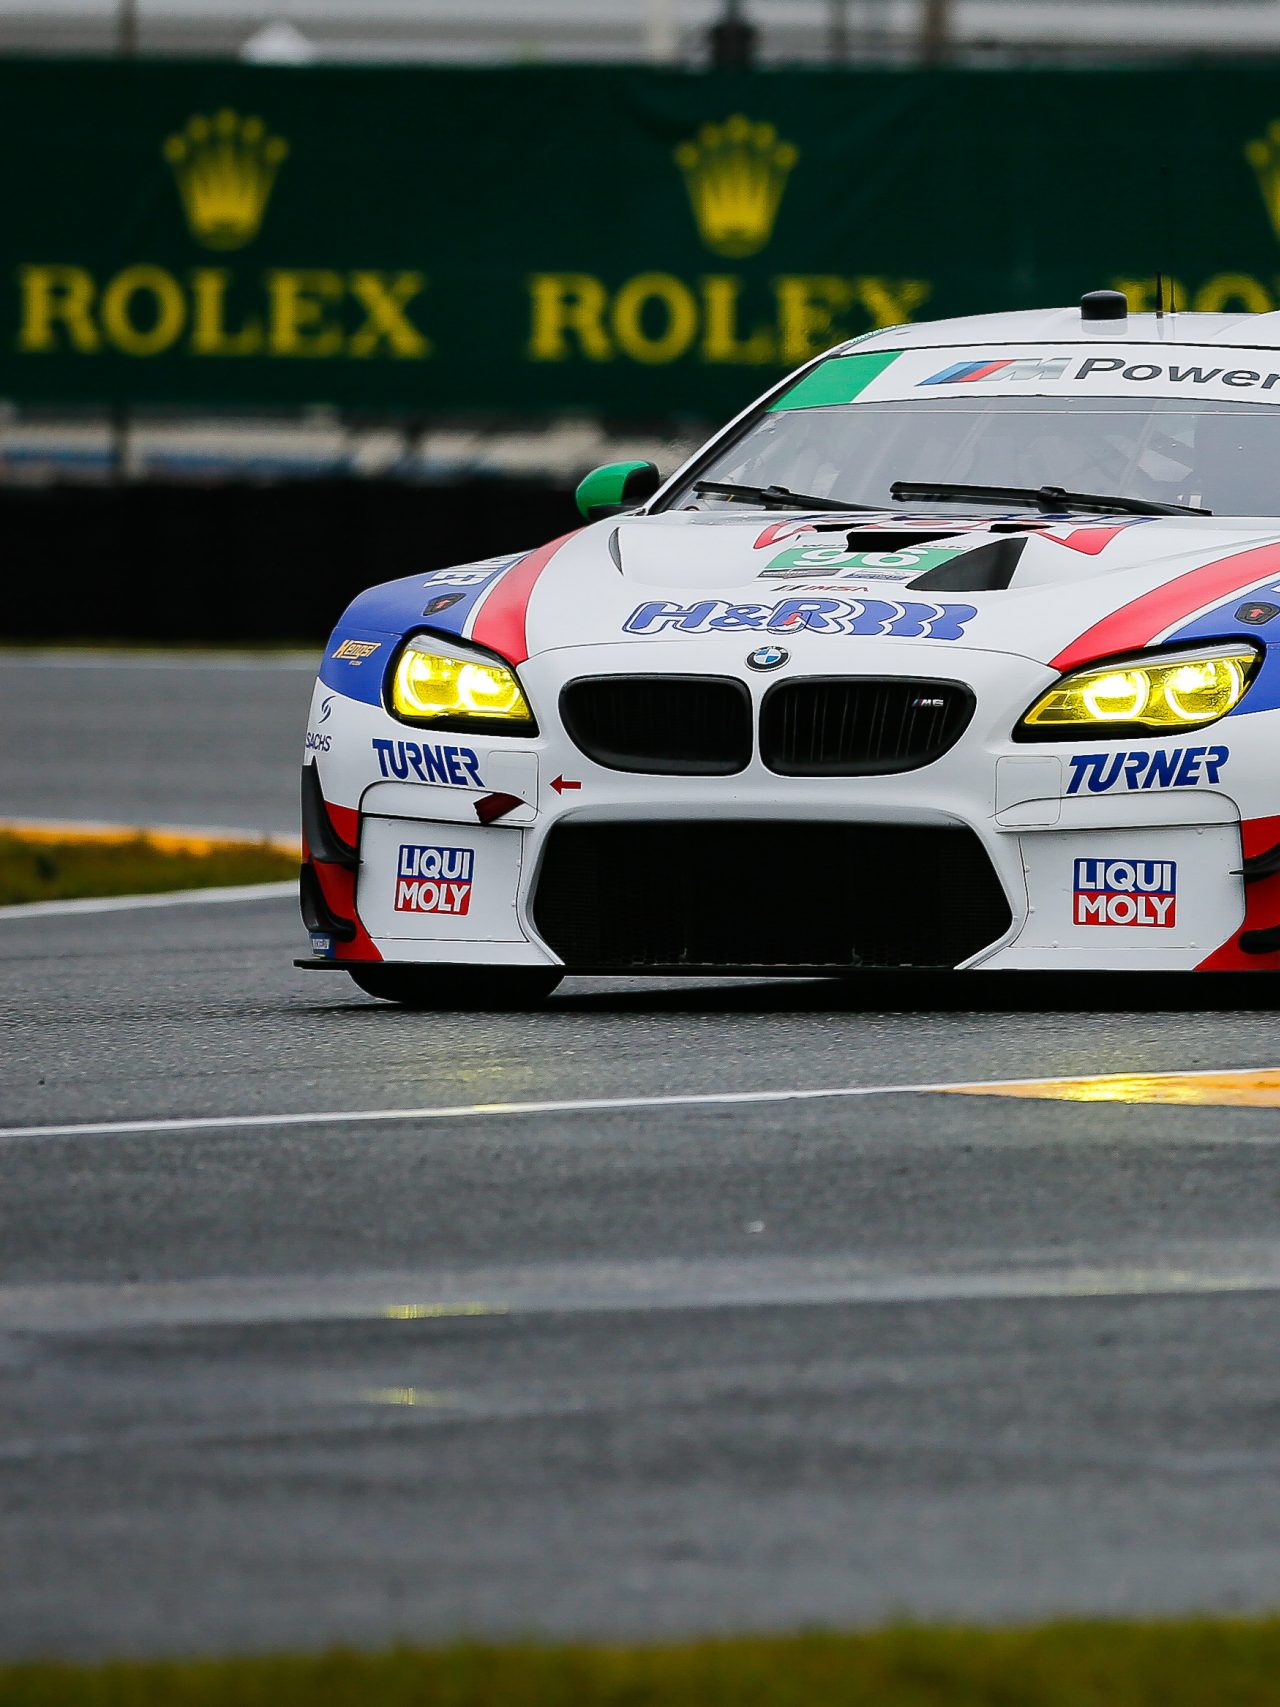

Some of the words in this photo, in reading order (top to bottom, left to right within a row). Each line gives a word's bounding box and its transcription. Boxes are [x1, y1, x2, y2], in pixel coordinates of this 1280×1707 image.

[17, 265, 429, 357] ROLEX
[793, 549, 928, 567] 96
[622, 598, 848, 634] H&R
[305, 732, 332, 751] SACHS
[372, 738, 486, 788] TURNER
[1066, 745, 1229, 794] TURNER
[400, 847, 471, 879] LIQUI
[1078, 861, 1173, 893] LIQUI
[397, 880, 471, 912] MOLY
[1078, 895, 1175, 925] MOLY
